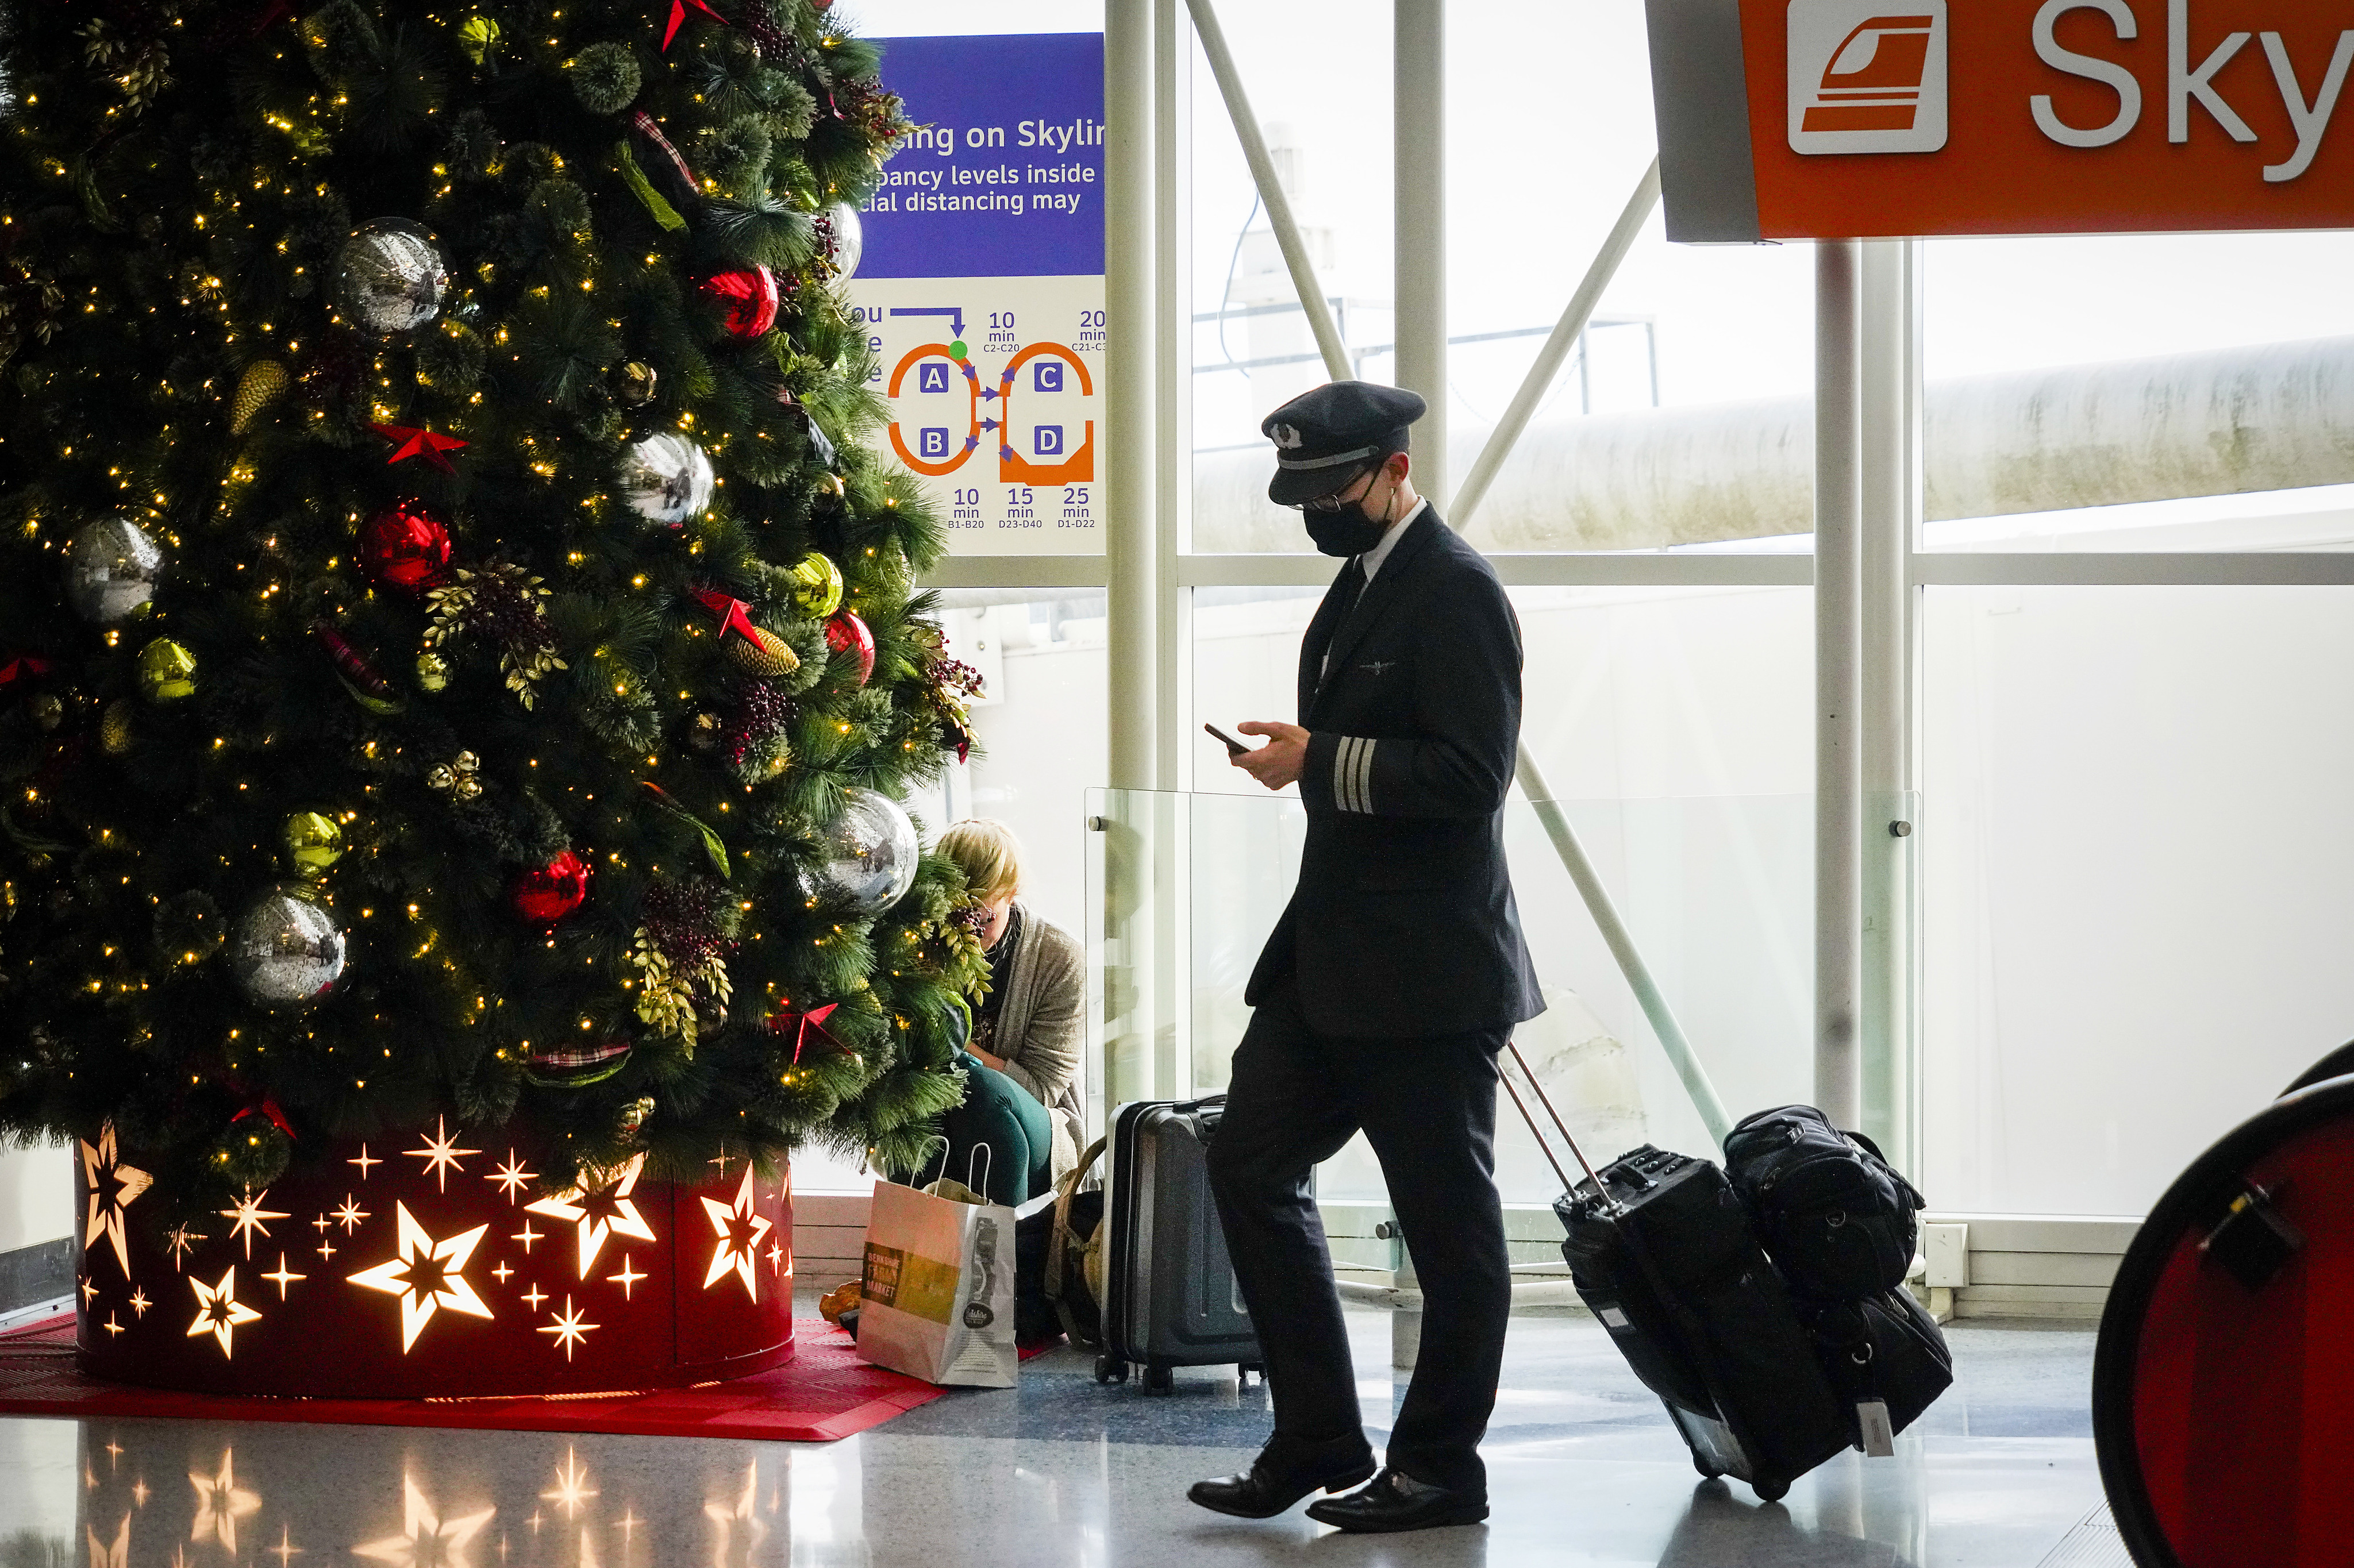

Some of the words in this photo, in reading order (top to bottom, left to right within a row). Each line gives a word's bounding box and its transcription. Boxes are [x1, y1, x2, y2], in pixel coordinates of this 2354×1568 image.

[2030, 0, 2354, 182] Sky
[966, 126, 1005, 148] on
[951, 164, 1019, 185] levels
[1028, 163, 1095, 183] inside
[905, 191, 1024, 215] distancing
[1033, 194, 1081, 214] may
[842, 303, 882, 323] ou
[989, 312, 1015, 329] 10
[1080, 310, 1105, 327] 20
[988, 330, 1015, 342] min
[1080, 329, 1105, 341] min
[983, 344, 1020, 352] C2-C20
[925, 368, 944, 389] A
[1040, 367, 1057, 388] C
[926, 432, 943, 453] B
[1040, 430, 1057, 451] D
[954, 488, 979, 505] 10
[1007, 488, 1033, 504] 15
[1063, 487, 1089, 504] 25
[953, 506, 979, 518] min
[1007, 506, 1033, 518] min
[1063, 505, 1089, 518] min
[948, 520, 984, 529] B1-B20
[999, 520, 1042, 528] D23-D40
[1058, 519, 1095, 528] D1-D22
[866, 1279, 896, 1298] MARKET
